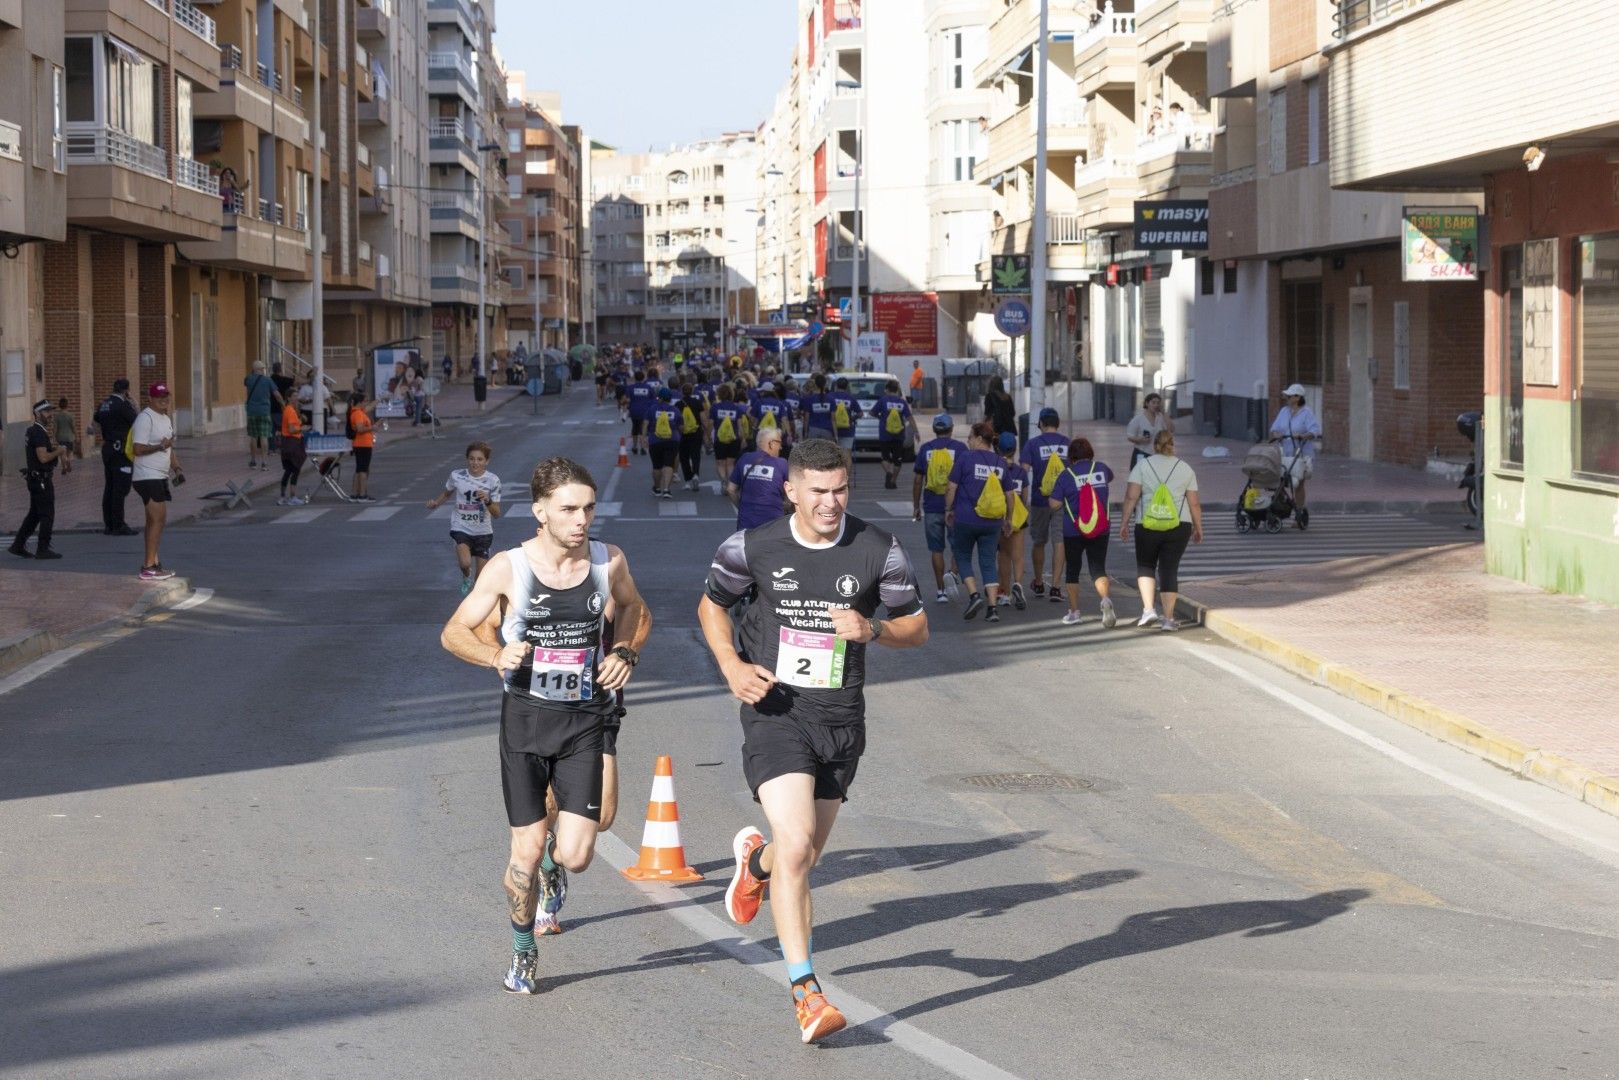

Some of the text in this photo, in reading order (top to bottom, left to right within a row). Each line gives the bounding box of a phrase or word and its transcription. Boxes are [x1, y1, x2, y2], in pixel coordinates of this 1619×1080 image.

[1444, 215, 1475, 230] ВАНЯ
[1140, 231, 1208, 243] SUPERMER
[1004, 310, 1024, 318] BUS
[780, 600, 851, 610] CLUB ATLETISMO
[775, 608, 806, 617] PUERTO
[526, 629, 557, 638] PUERTO
[543, 651, 551, 662] X
[795, 657, 812, 676] 2
[537, 671, 579, 690] 118
